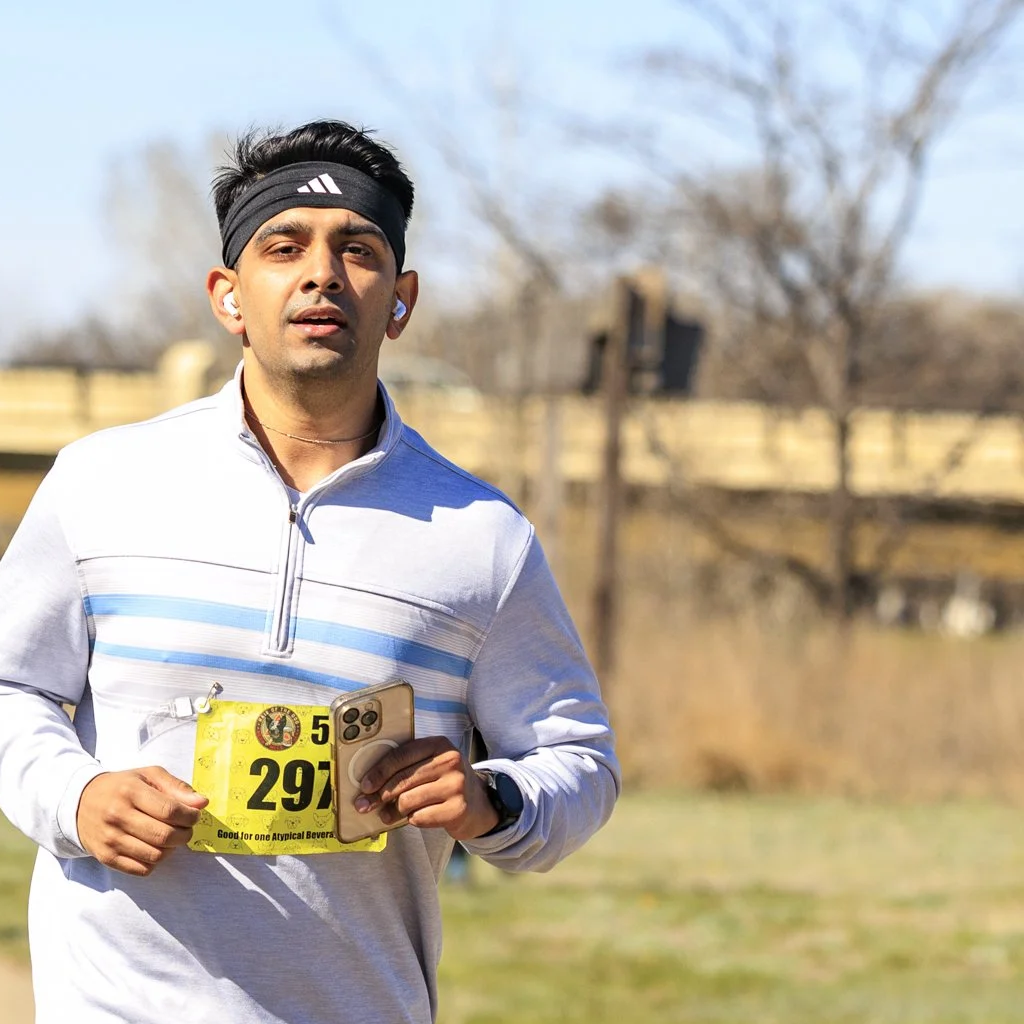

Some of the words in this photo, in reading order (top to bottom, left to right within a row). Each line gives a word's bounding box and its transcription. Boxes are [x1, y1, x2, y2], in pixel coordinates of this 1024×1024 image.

[311, 715, 329, 745] 5
[246, 757, 333, 811] 297
[217, 829, 239, 840] Good
[240, 831, 252, 840] for
[254, 833, 270, 841] one
[271, 831, 304, 842] Atypical
[306, 830, 335, 839] Bevera
